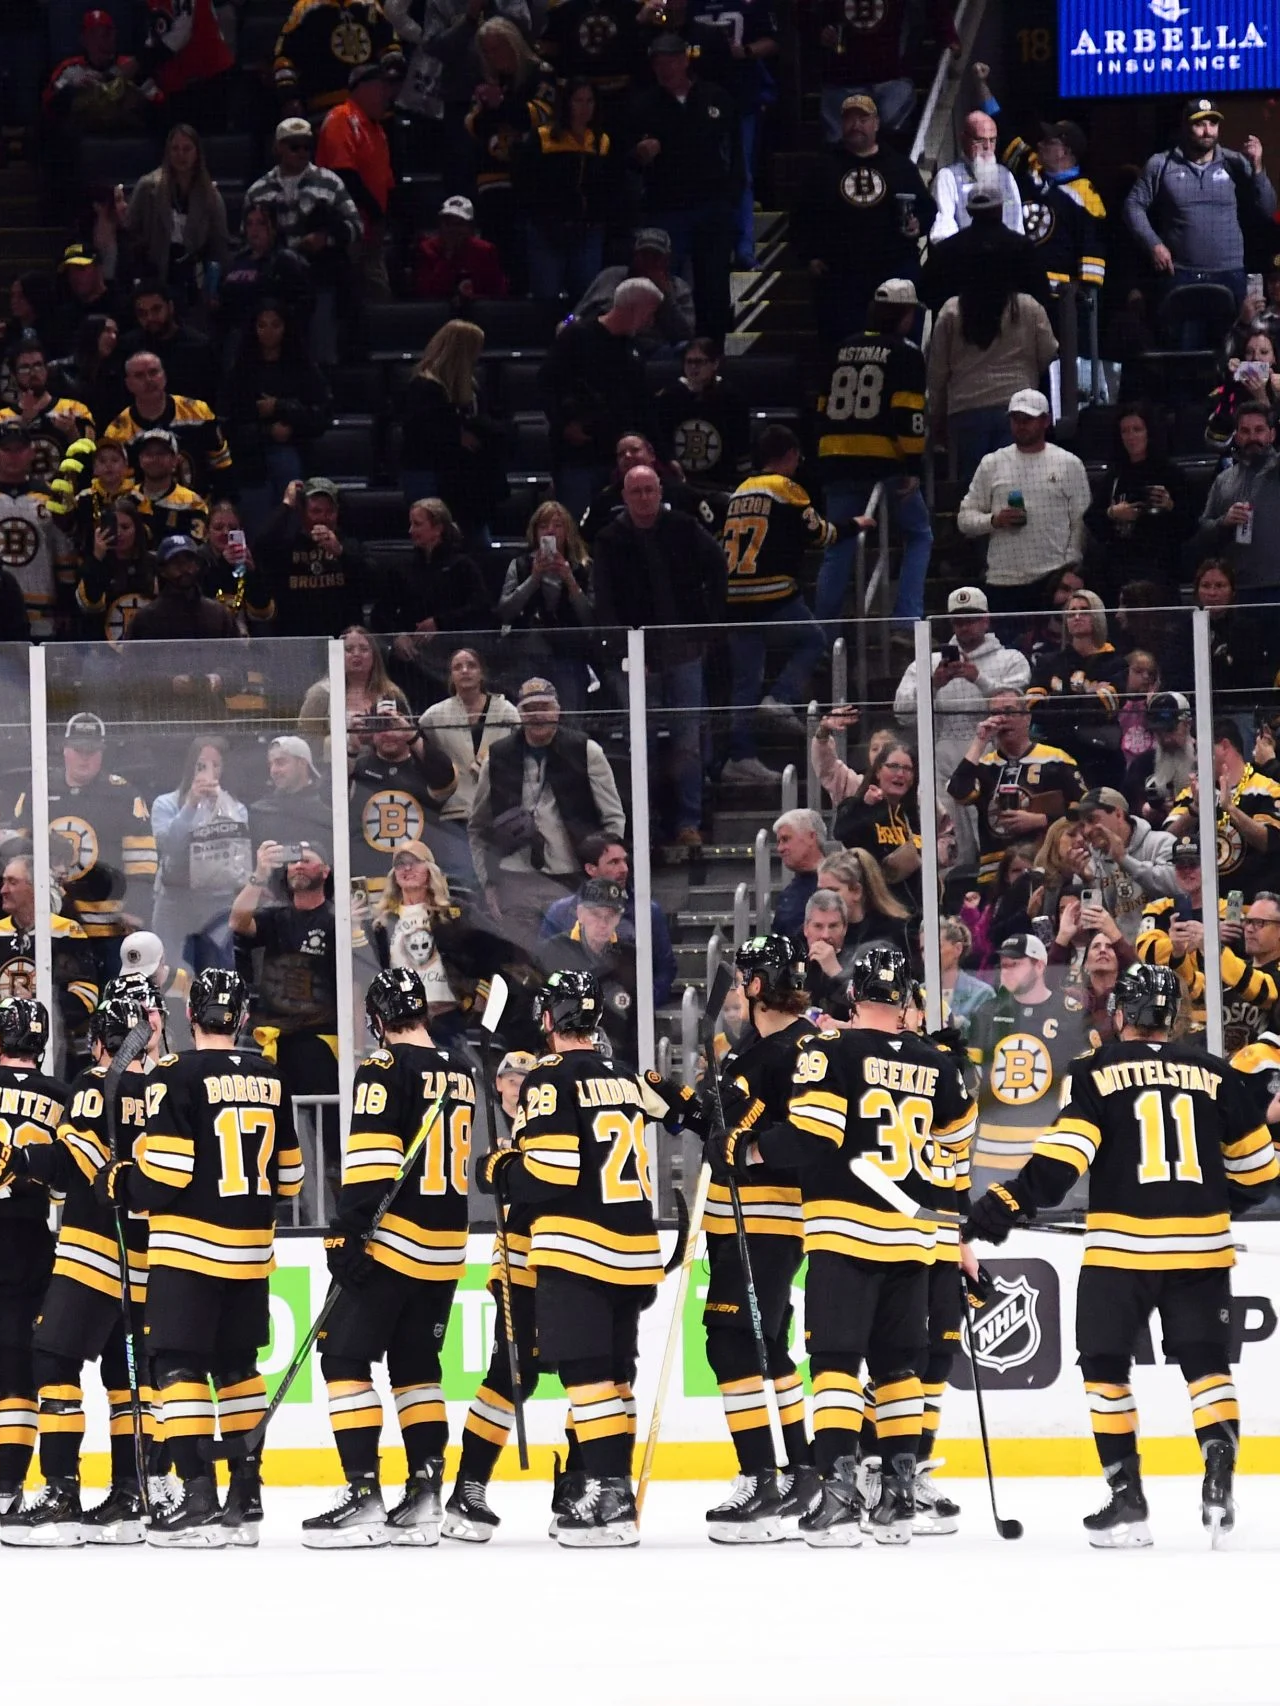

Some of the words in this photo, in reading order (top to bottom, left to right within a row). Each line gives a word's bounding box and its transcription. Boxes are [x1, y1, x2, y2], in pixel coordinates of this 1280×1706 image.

[1017, 28, 1051, 63] 18
[1070, 22, 1267, 56] ARBELLA
[1097, 55, 1241, 75] INSURANCE
[826, 364, 884, 420] 88
[3, 529, 27, 553] B
[379, 804, 407, 838] B
[1042, 1018, 1058, 1038] C
[792, 1050, 829, 1084] 39
[863, 1056, 940, 1097] GEEKIE
[1004, 1049, 1037, 1090] B
[71, 1088, 104, 1118] 10
[203, 1074, 282, 1107] BORGEN
[354, 1083, 388, 1115] 18
[526, 1084, 557, 1118] 28
[214, 1107, 276, 1198] 17
[1134, 1090, 1203, 1185] 11
[978, 1299, 1025, 1351] NHL
[126, 1343, 138, 1391] BAUER
